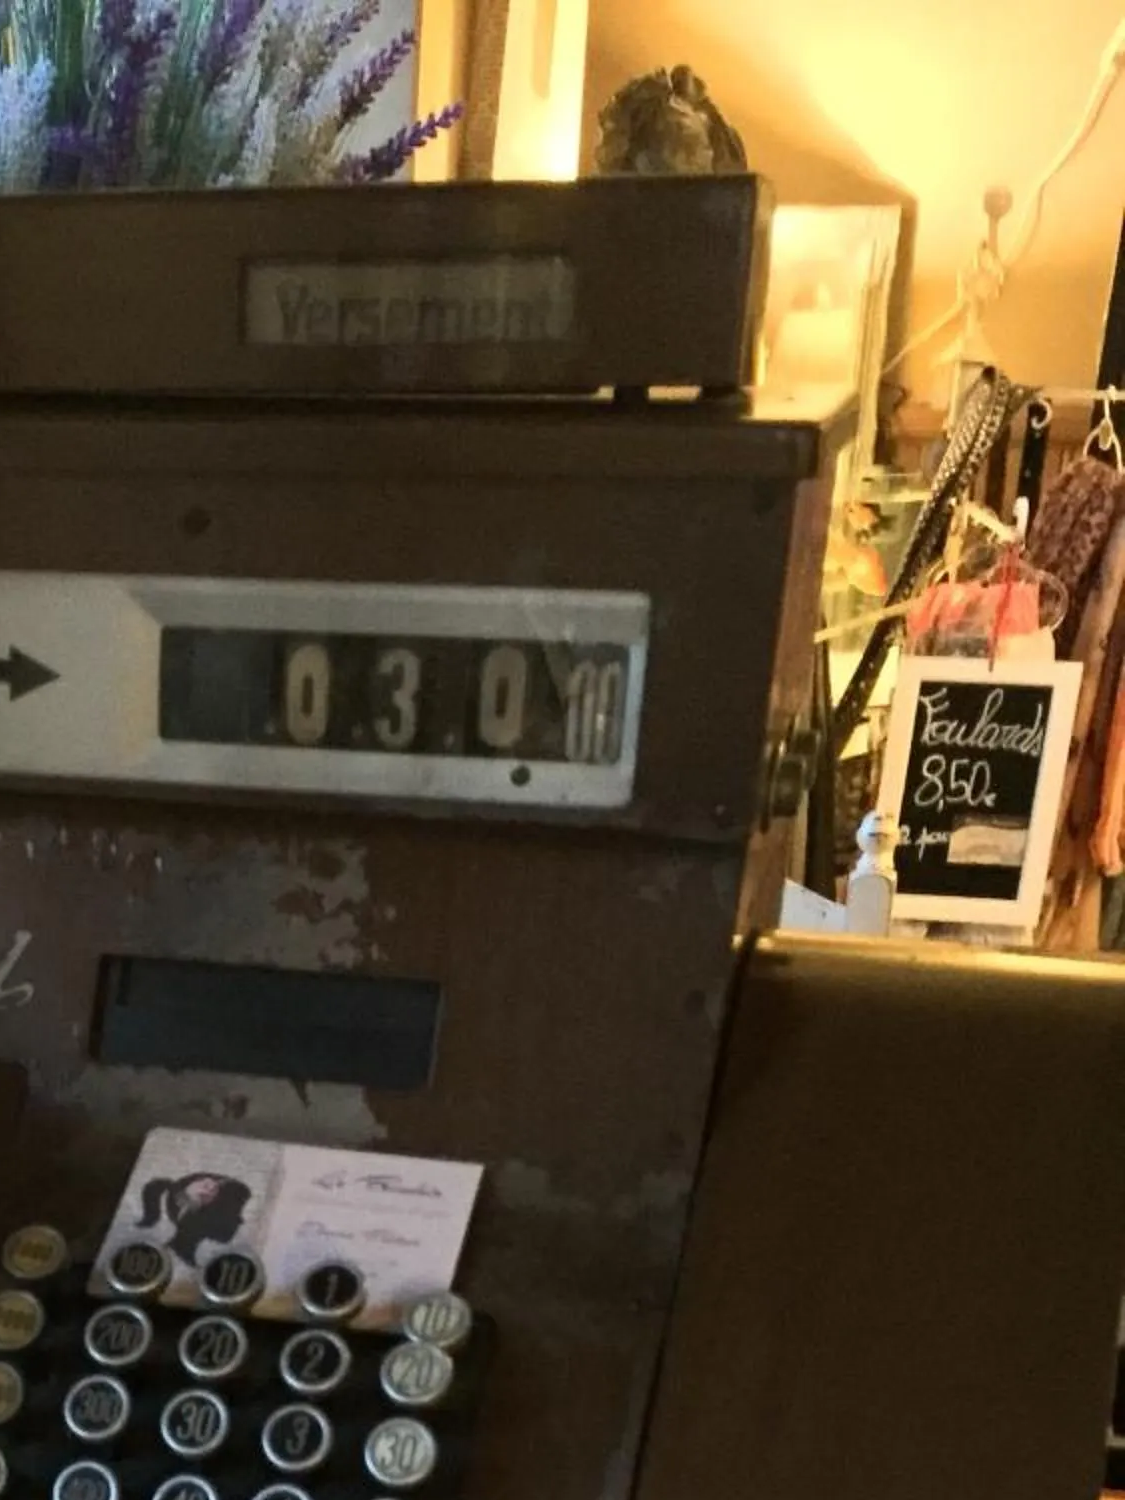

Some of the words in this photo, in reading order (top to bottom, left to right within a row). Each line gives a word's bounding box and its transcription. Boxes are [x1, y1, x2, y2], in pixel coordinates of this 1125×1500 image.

[217, 1255, 252, 1287] 10
[326, 1273, 338, 1302] 1
[193, 1330, 232, 1366] 20
[301, 1344, 326, 1378] 2
[176, 1402, 216, 1441] 30
[285, 1417, 309, 1454] 3
[379, 1434, 416, 1469] 30
